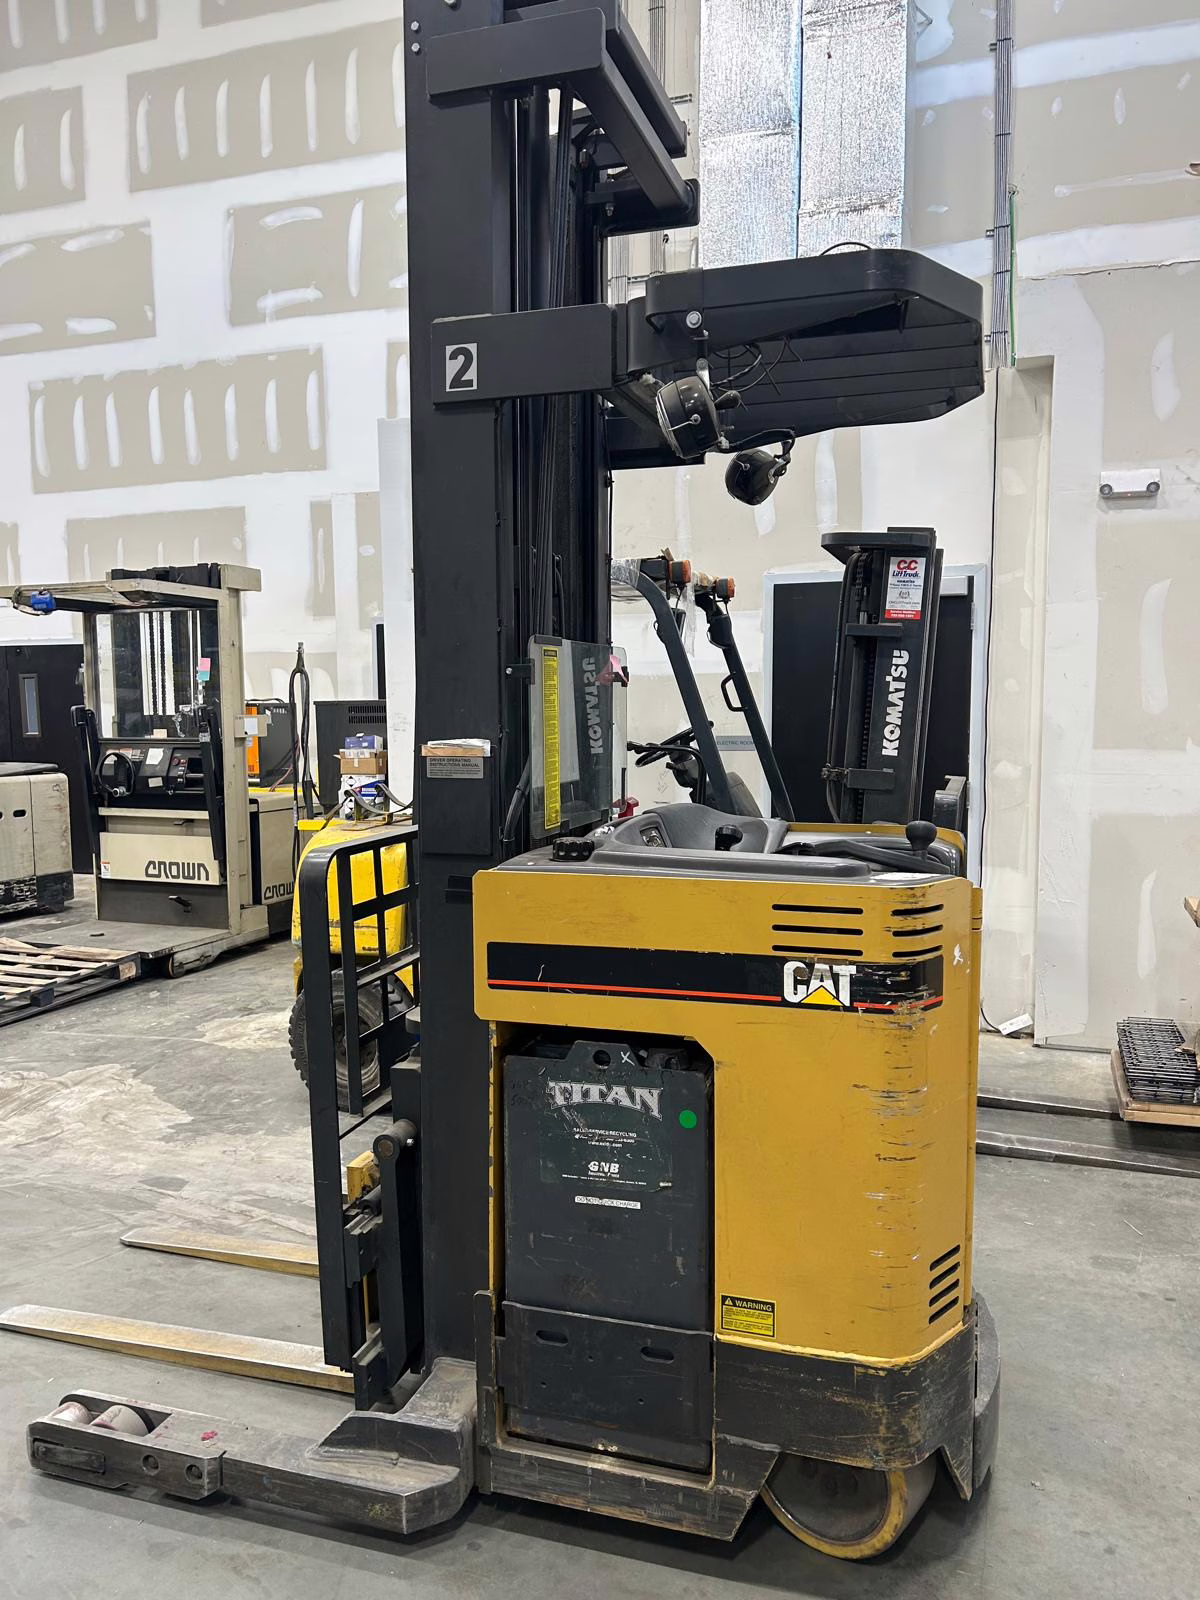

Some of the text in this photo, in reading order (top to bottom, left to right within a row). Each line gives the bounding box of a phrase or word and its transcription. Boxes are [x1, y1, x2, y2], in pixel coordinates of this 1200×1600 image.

[449, 346, 474, 389] 2
[882, 649, 910, 756] KOMATSU
[144, 860, 209, 881] CROWN
[264, 881, 295, 900] CROW
[783, 960, 857, 1007] CAT
[546, 1079, 664, 1121] TITAN
[588, 1161, 620, 1174] GNB
[735, 1300, 773, 1311] WARNING
